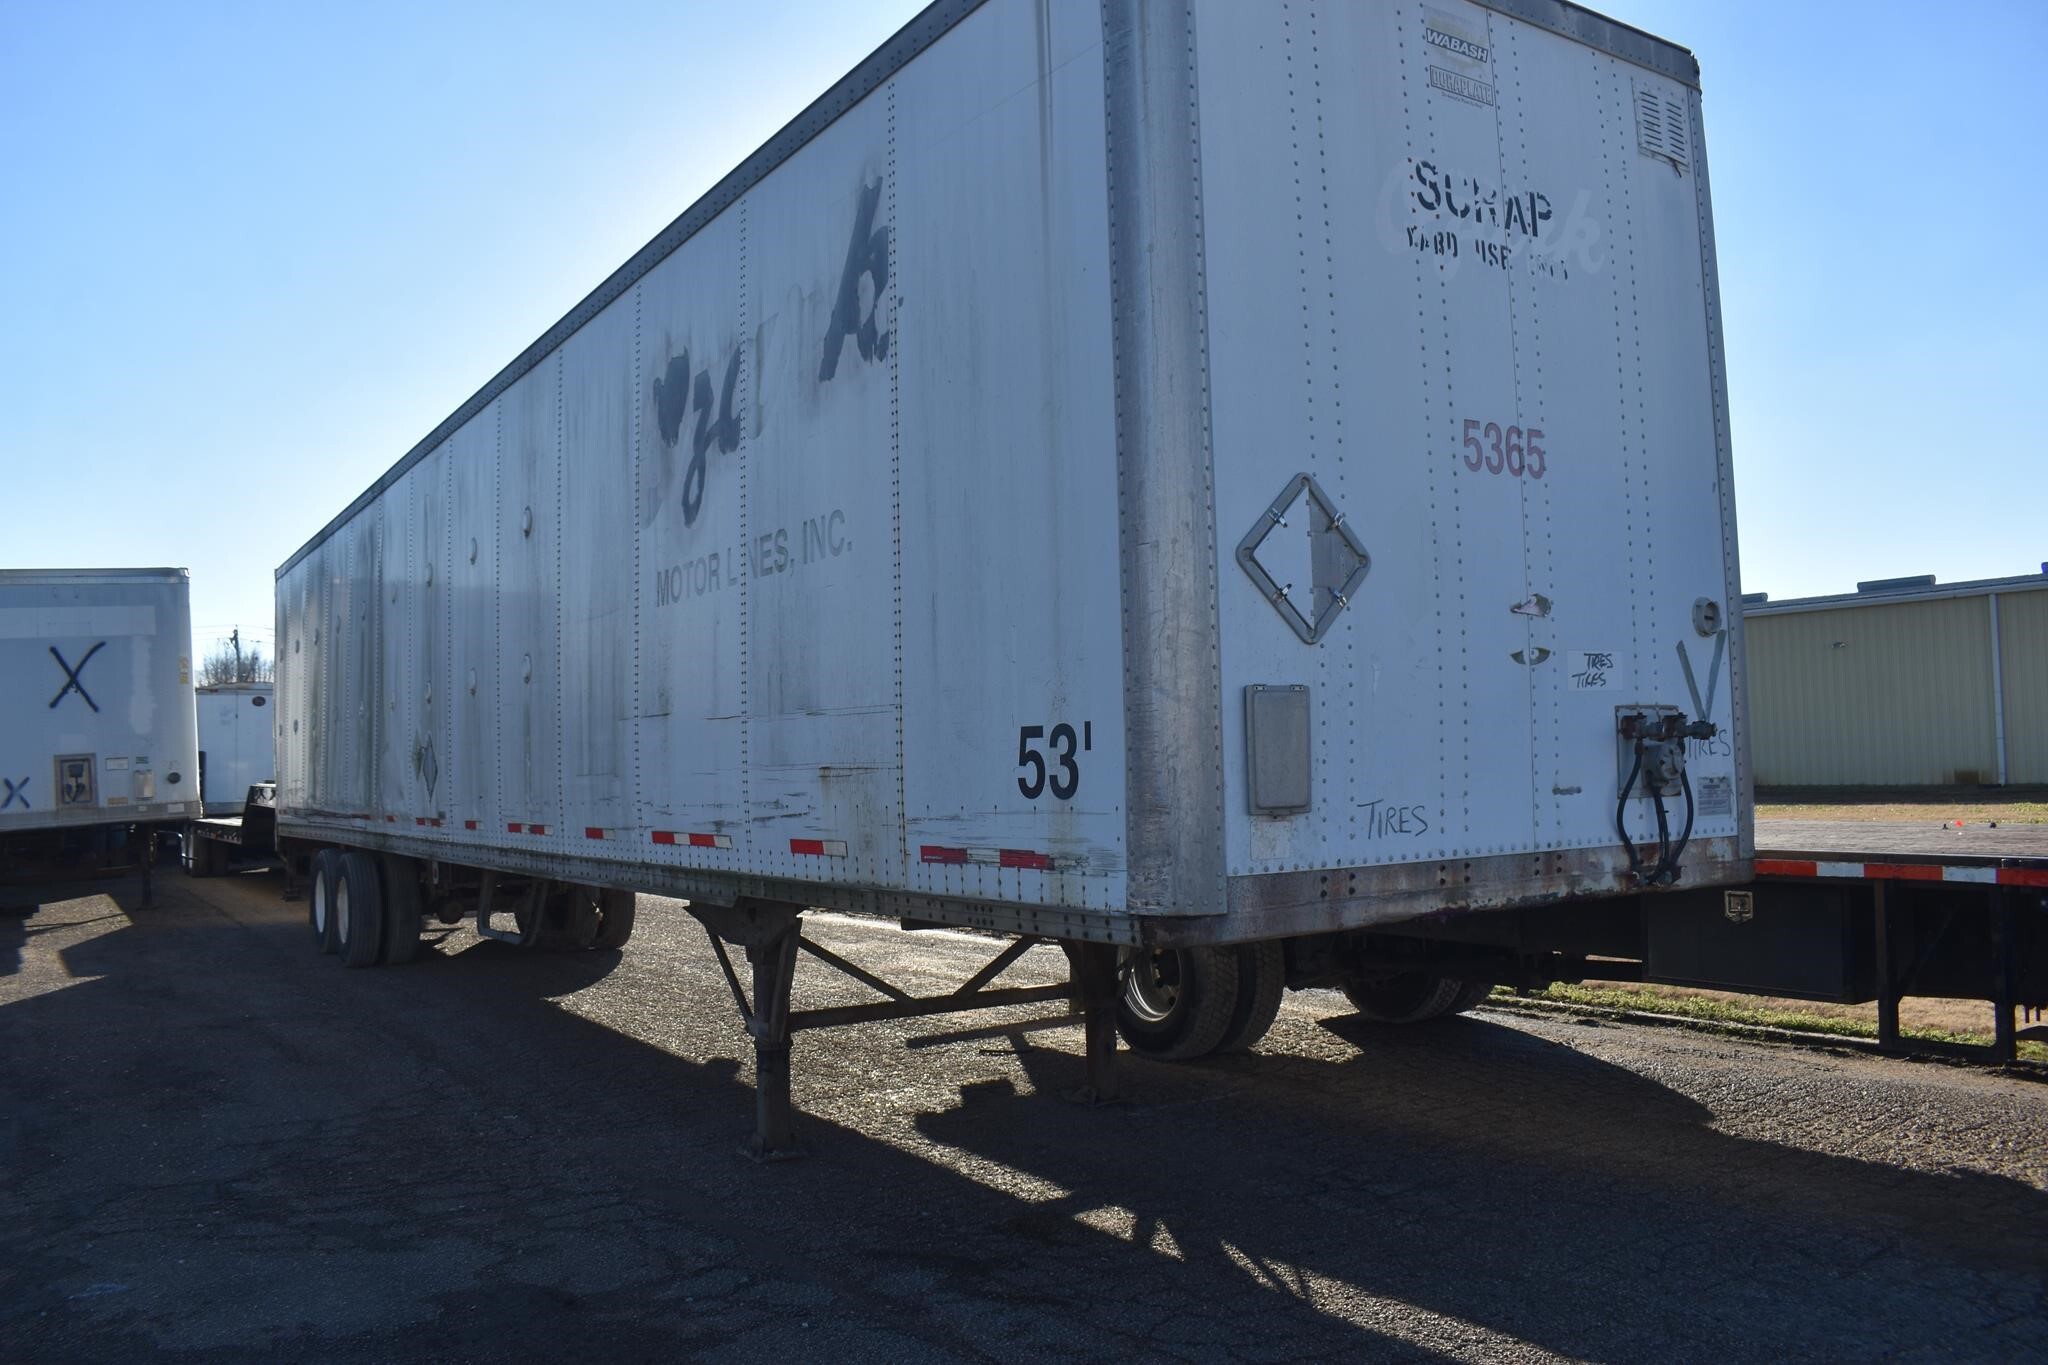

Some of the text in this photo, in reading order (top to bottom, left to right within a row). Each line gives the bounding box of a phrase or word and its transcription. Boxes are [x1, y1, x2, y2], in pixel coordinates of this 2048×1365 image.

[1426, 28, 1488, 63] WABASH
[1415, 160, 1552, 237] SCRAP
[1463, 418, 1546, 480] 5365
[656, 508, 852, 607] MOTOR LNES, INC.
[1017, 720, 1092, 800] 53'
[1357, 799, 1428, 840] TIRES
